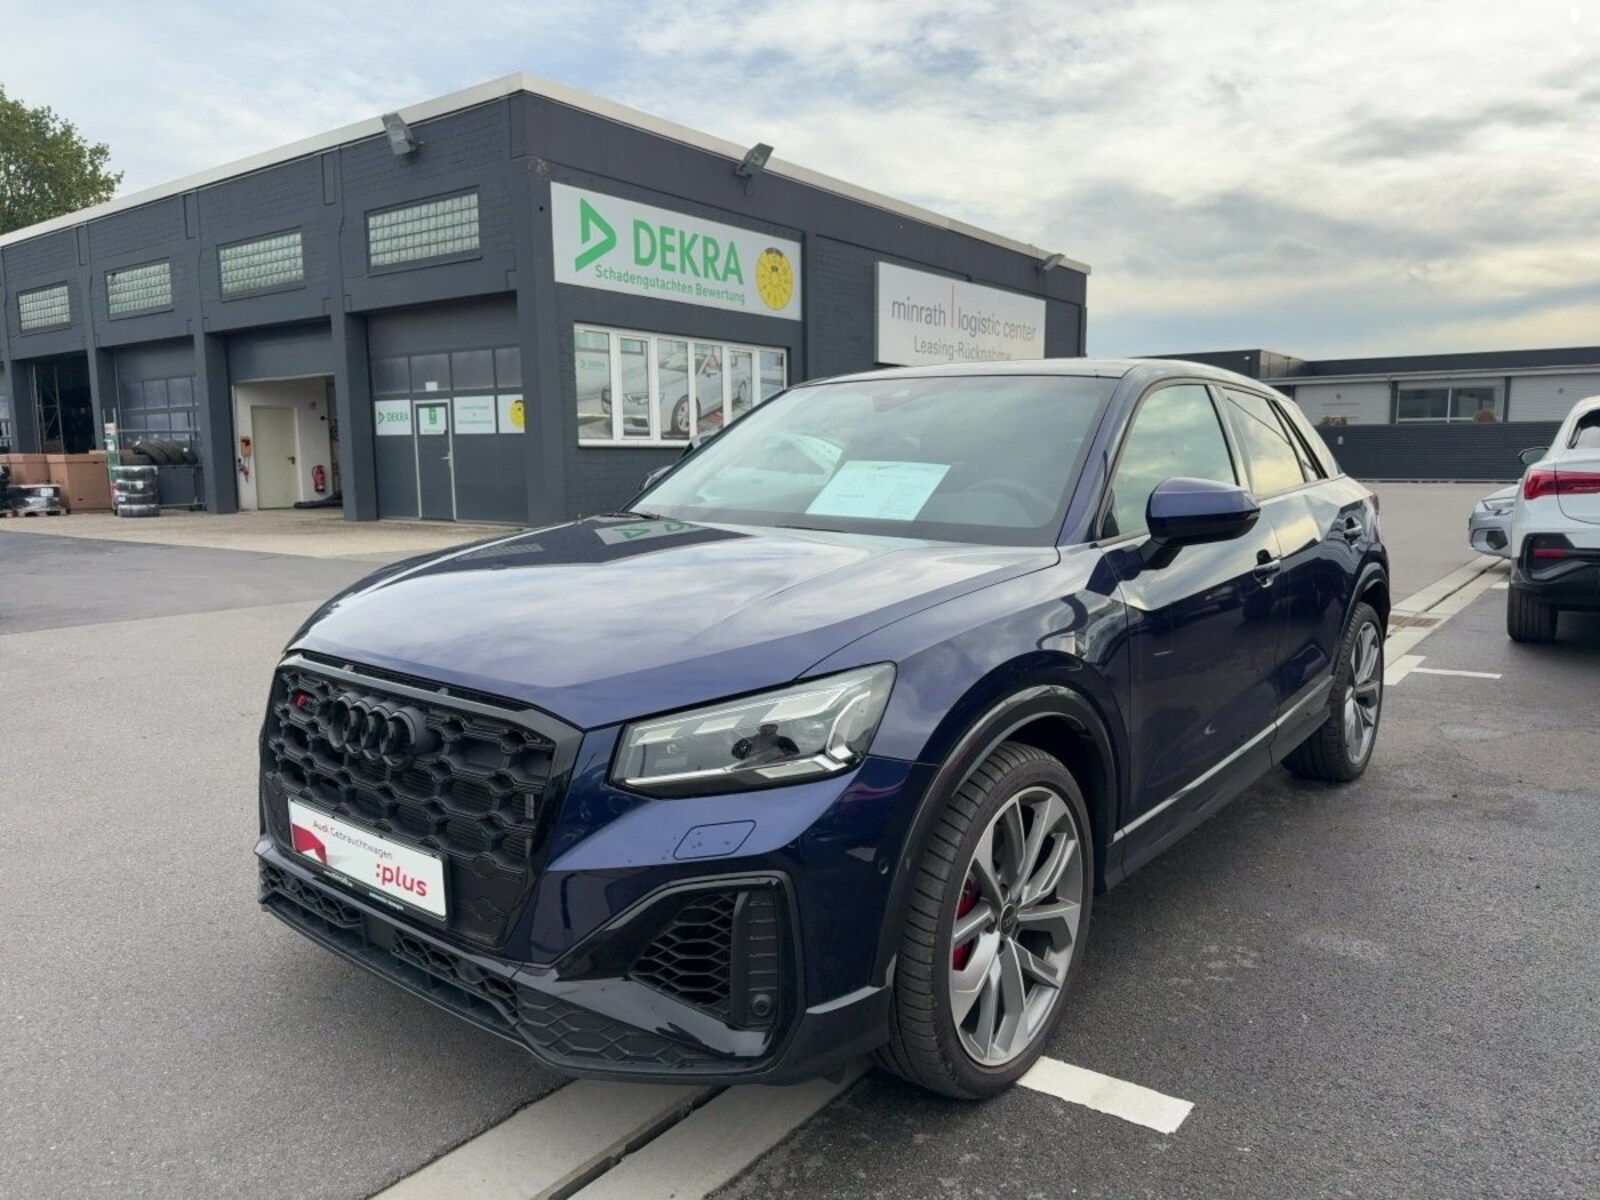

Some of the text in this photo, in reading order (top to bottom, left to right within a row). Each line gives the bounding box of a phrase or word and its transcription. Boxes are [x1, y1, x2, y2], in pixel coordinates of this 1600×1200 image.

[633, 219, 744, 285] DEKRA
[595, 264, 745, 305] Schadengutachten Bewertung
[891, 296, 1037, 342] minrath logistic center
[386, 411, 409, 424] DEKRA
[312, 819, 393, 860] Audi Gebrauchtwagen
